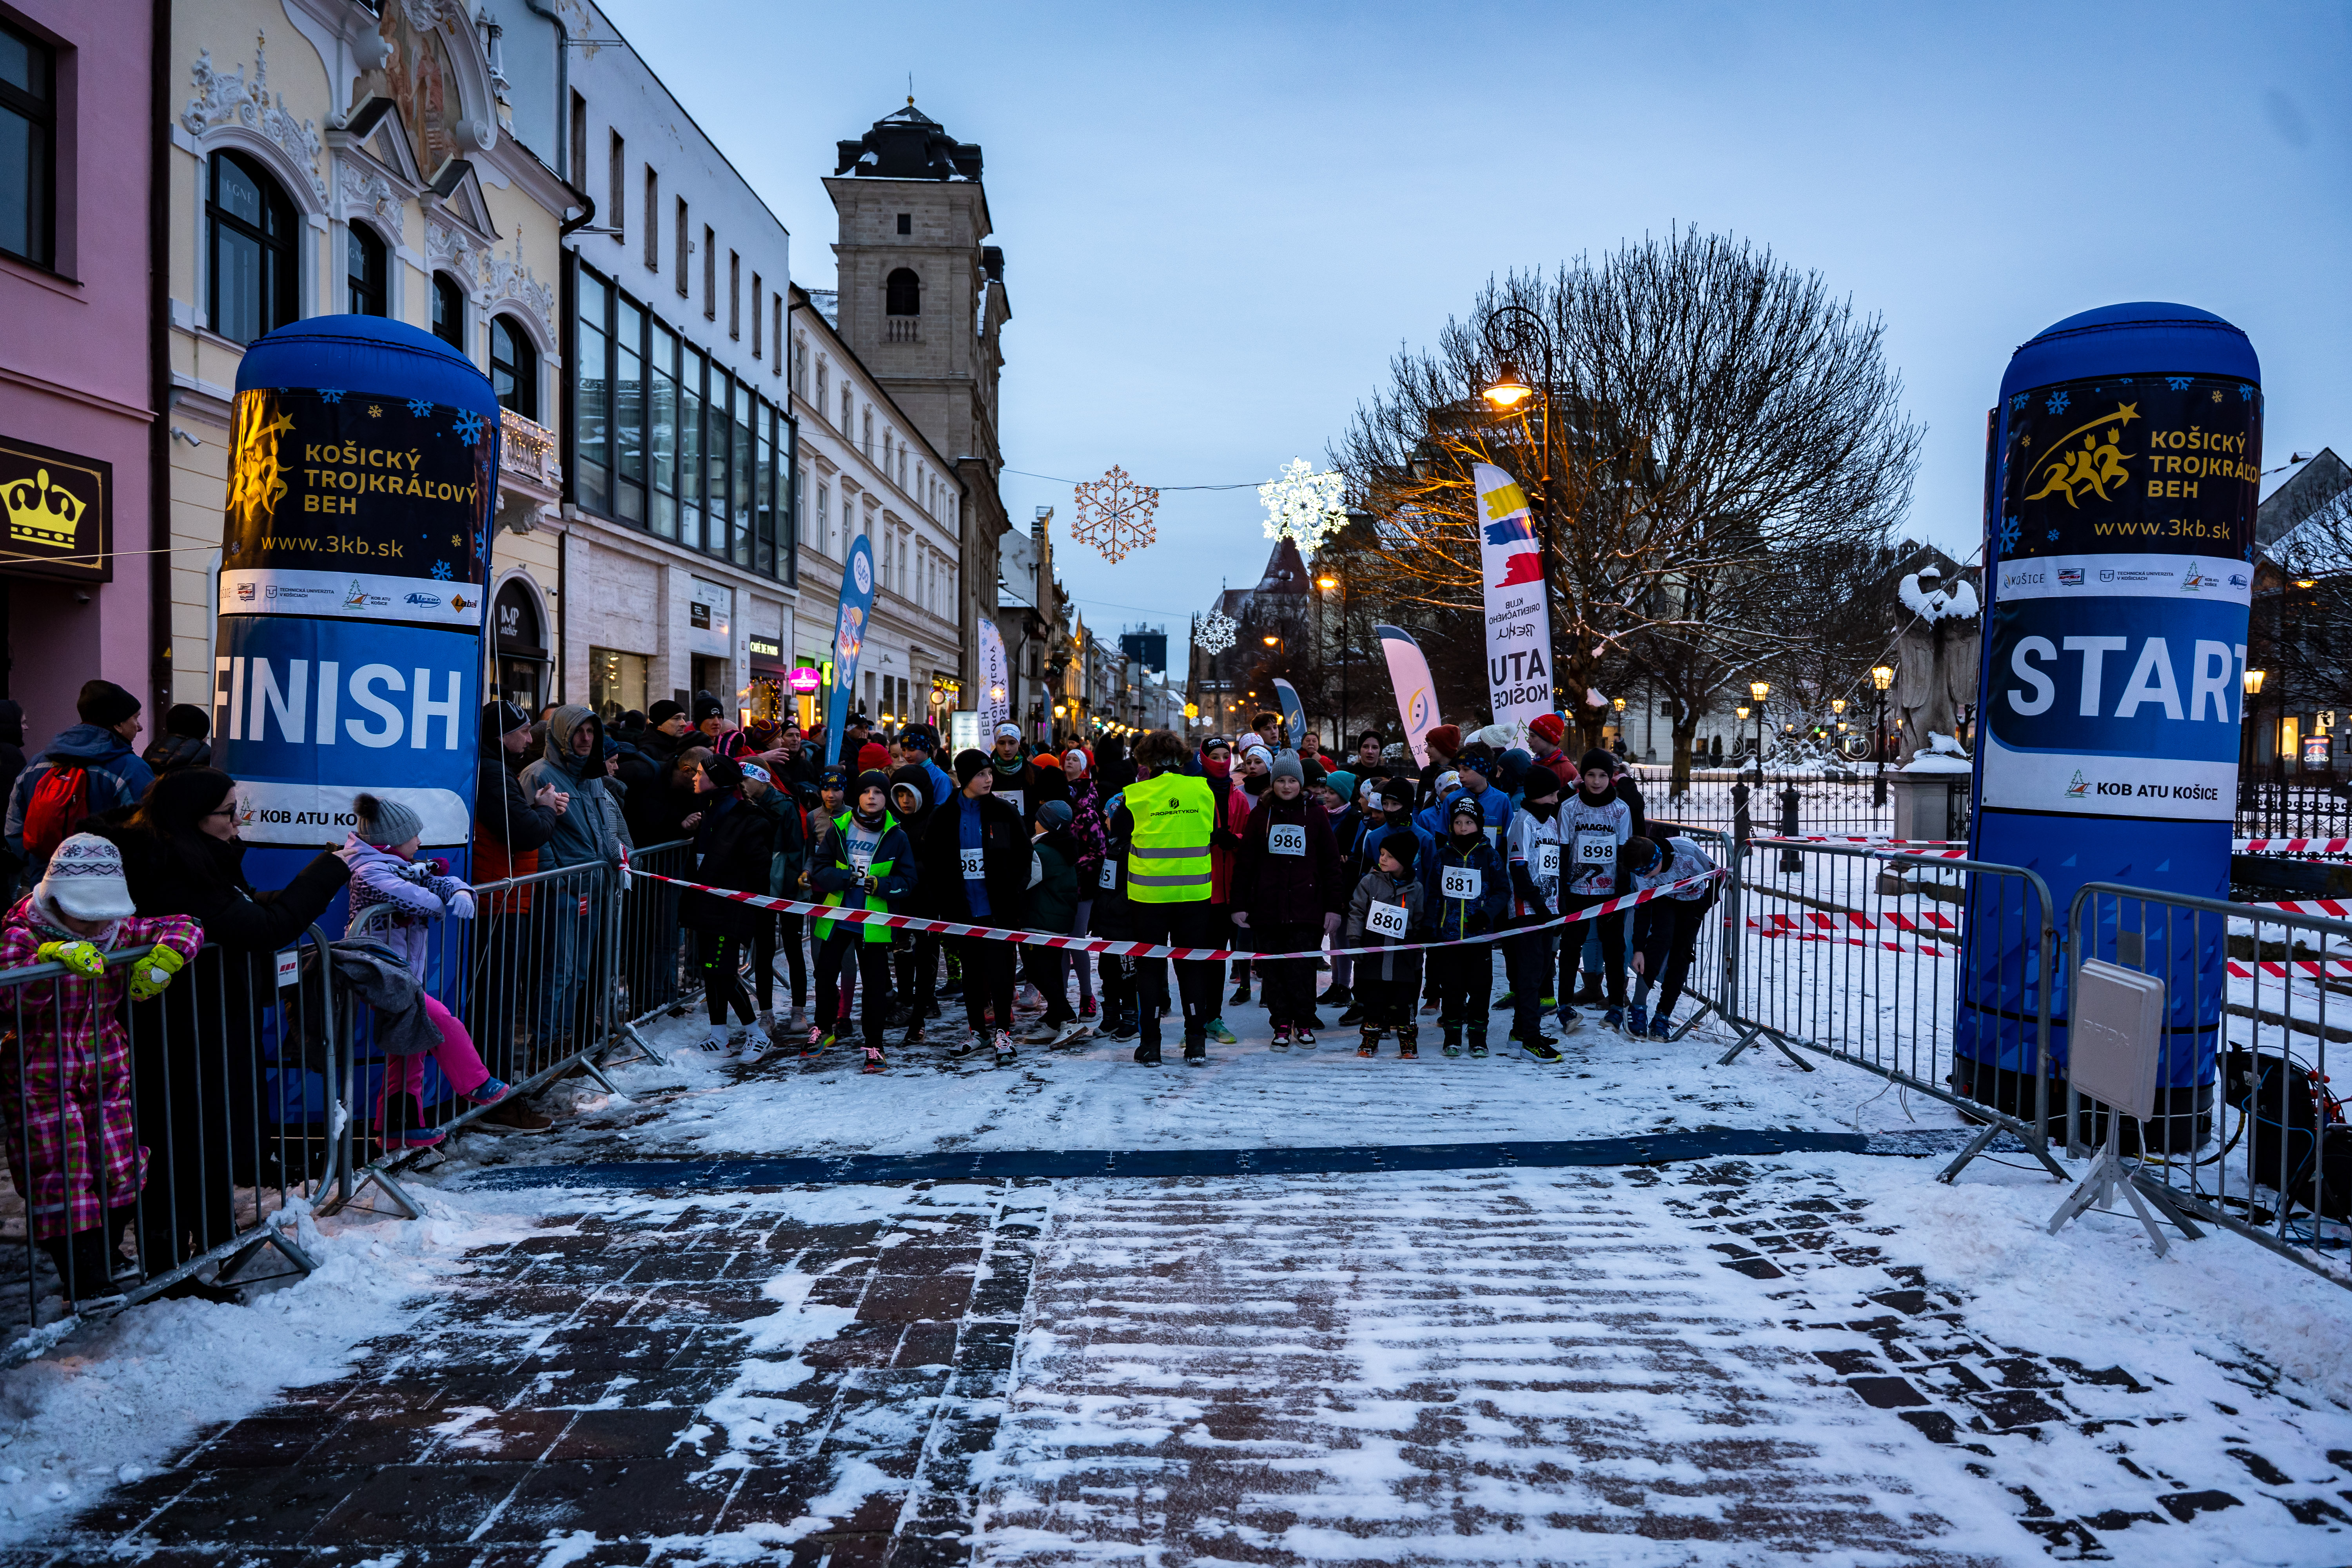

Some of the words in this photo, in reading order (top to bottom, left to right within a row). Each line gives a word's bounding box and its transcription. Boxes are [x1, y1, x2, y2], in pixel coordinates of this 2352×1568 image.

[2151, 426, 2245, 454] KOŠICKÝ
[305, 440, 421, 471] KOŠICKÝ
[304, 469, 477, 505] TROJKRÁĽOVÝ
[2147, 480, 2198, 498] BEH
[305, 495, 356, 515] BEH
[2094, 519, 2230, 540] www.3kb.sk
[261, 535, 404, 558] www.3kb.sk
[2011, 572, 2045, 585] KOŠICE
[750, 641, 761, 653] CAFÉ
[761, 644, 767, 654] DE
[767, 645, 779, 656] PARIS
[212, 657, 461, 750] FINISH
[2097, 782, 2132, 796] KOB
[2137, 785, 2169, 798] ATU
[2173, 784, 2218, 801] KOŠICE
[260, 810, 291, 823] KOB
[296, 812, 329, 825] ATU
[1150, 808, 1199, 817] PROPERTYKON
[1273, 834, 1302, 849] 986
[1583, 845, 1613, 858] 898
[961, 858, 985, 873] 982
[1543, 855, 1560, 869] 89
[1446, 877, 1473, 893] 881
[1372, 912, 1403, 931] 880
